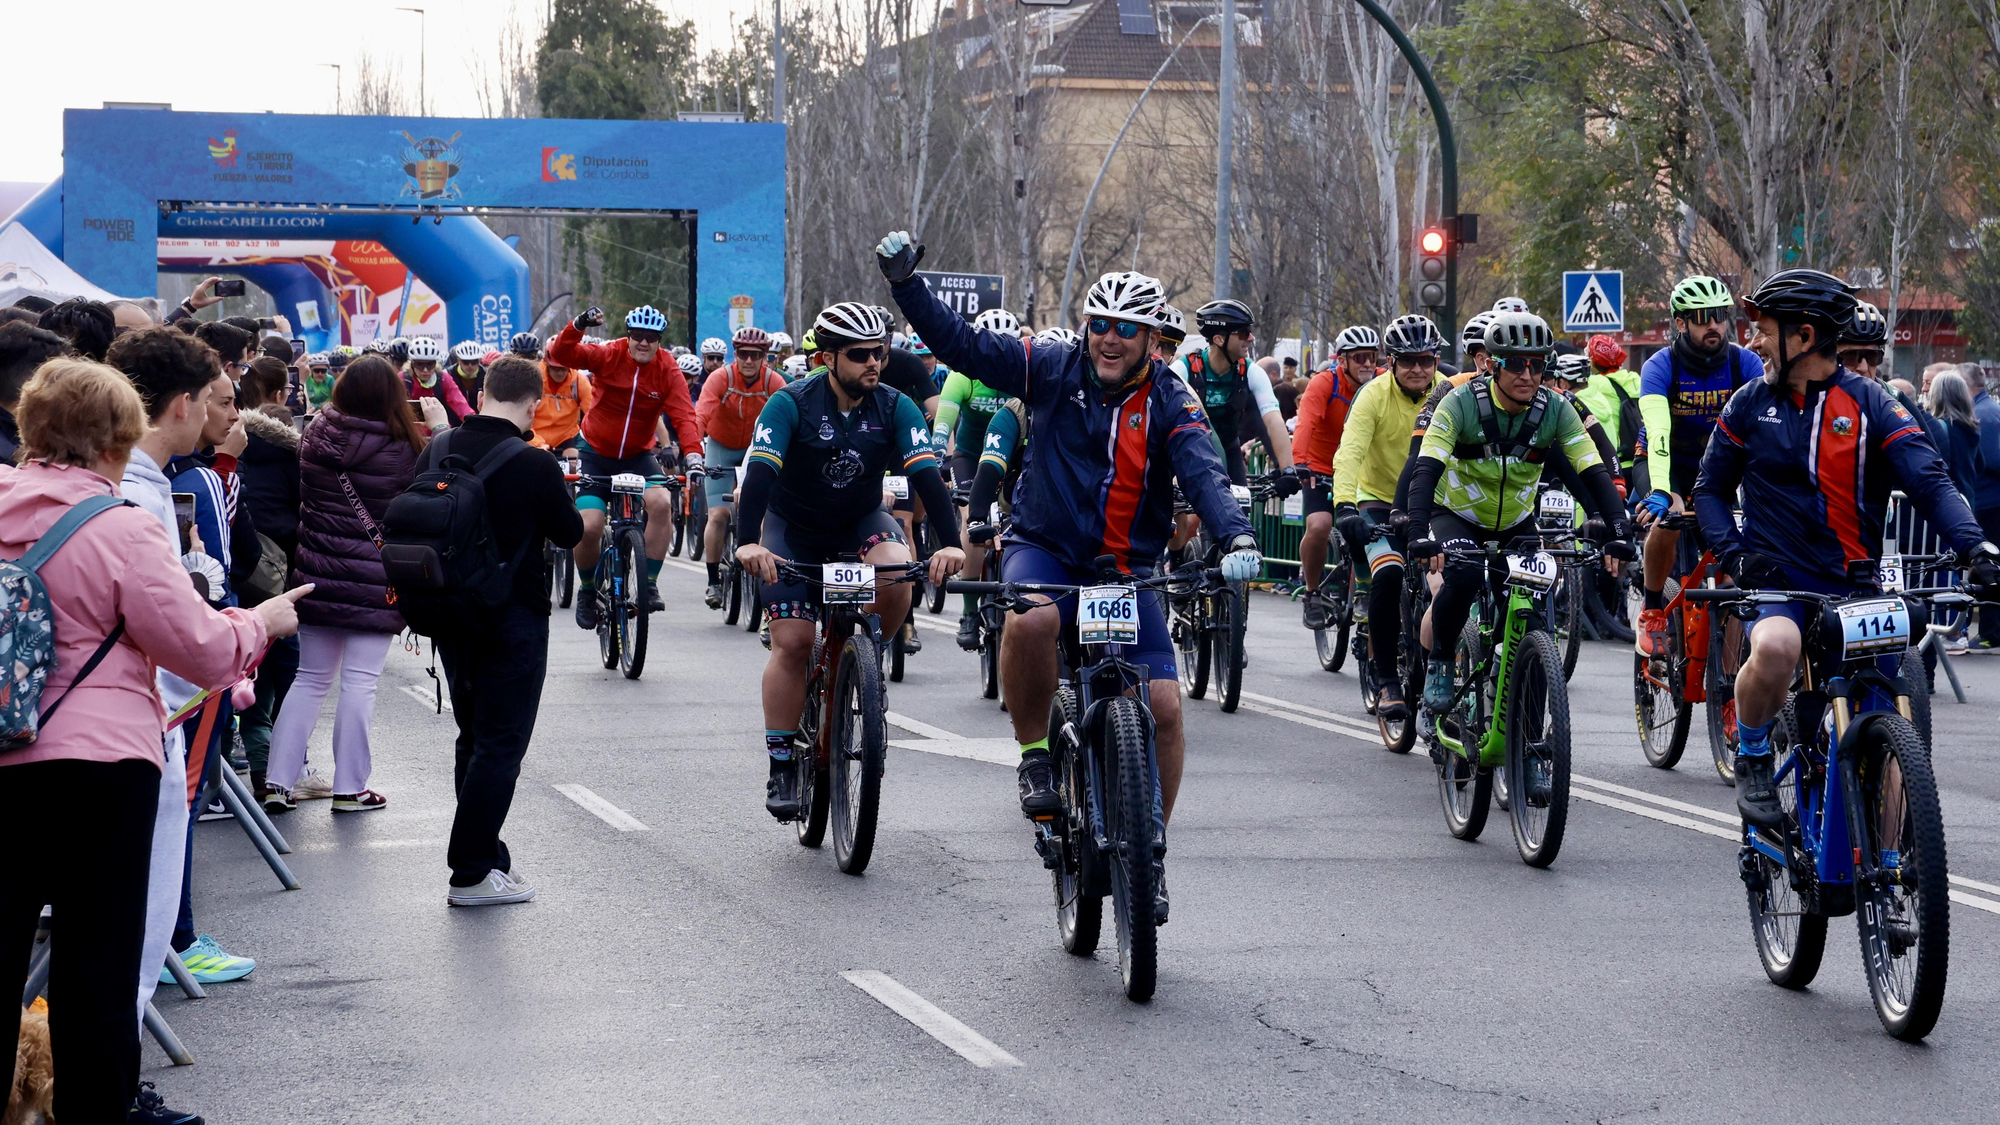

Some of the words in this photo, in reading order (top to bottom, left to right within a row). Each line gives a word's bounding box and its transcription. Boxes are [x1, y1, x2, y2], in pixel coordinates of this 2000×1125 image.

[259, 162, 293, 170] TIERRA
[582, 156, 648, 168] Diputación
[254, 174, 293, 183] VALORES
[582, 170, 597, 178] de
[602, 168, 649, 180] Córdoba
[83, 219, 135, 230] POWER
[107, 230, 135, 242] ADE
[226, 240, 240, 248] 902
[245, 240, 260, 248] 432
[941, 277, 976, 289] ACCESO
[937, 290, 980, 314] MTB
[499, 294, 513, 350] Ciclos
[1758, 416, 1782, 424] VIATOR
[756, 423, 772, 444] K
[910, 427, 929, 446] K
[986, 432, 1002, 448] K
[753, 446, 782, 458] xabank
[340, 472, 355, 497] LOLA
[1545, 497, 1568, 507] 1781
[354, 502, 374, 530] BIMBA
[1520, 558, 1546, 575] 400
[834, 569, 862, 582] 501
[1087, 601, 1131, 619] 1686
[1858, 615, 1895, 637] 114
